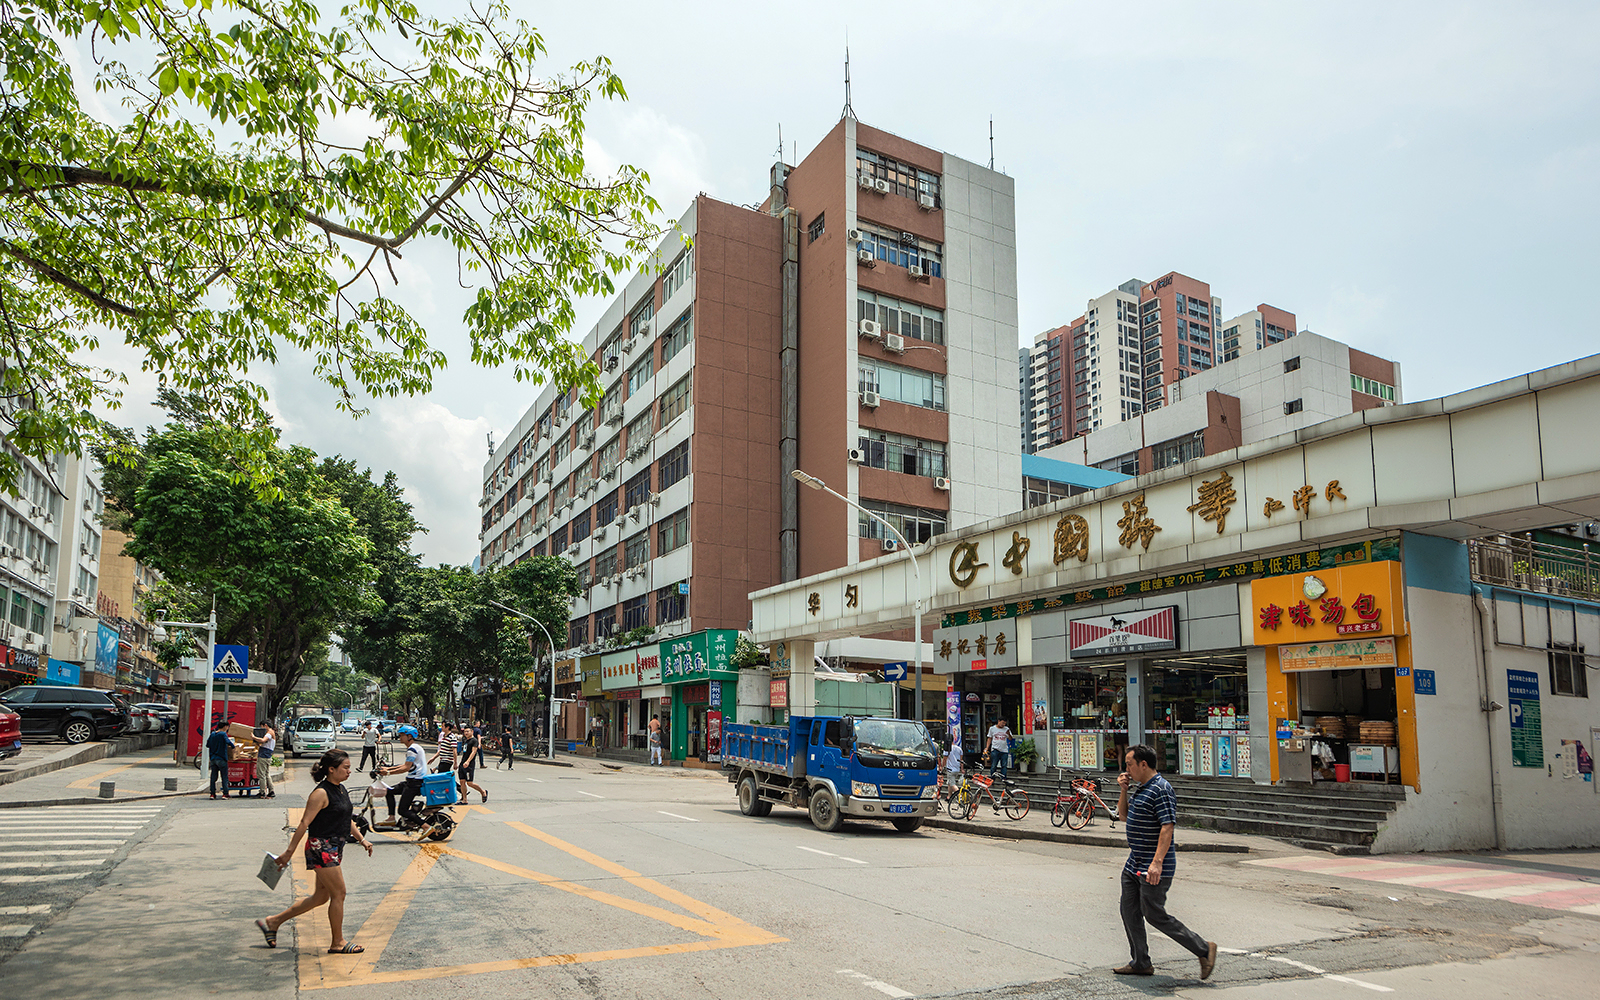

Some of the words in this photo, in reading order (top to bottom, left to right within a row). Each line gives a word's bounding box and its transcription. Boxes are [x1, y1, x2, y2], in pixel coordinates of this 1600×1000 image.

[1259, 592, 1382, 631] 津味汤包
[665, 652, 705, 677] 兰州拉面
[715, 634, 728, 672] 兰州拉面
[1419, 678, 1431, 688] 109
[1510, 703, 1522, 724] P
[884, 760, 918, 768] CHMC
